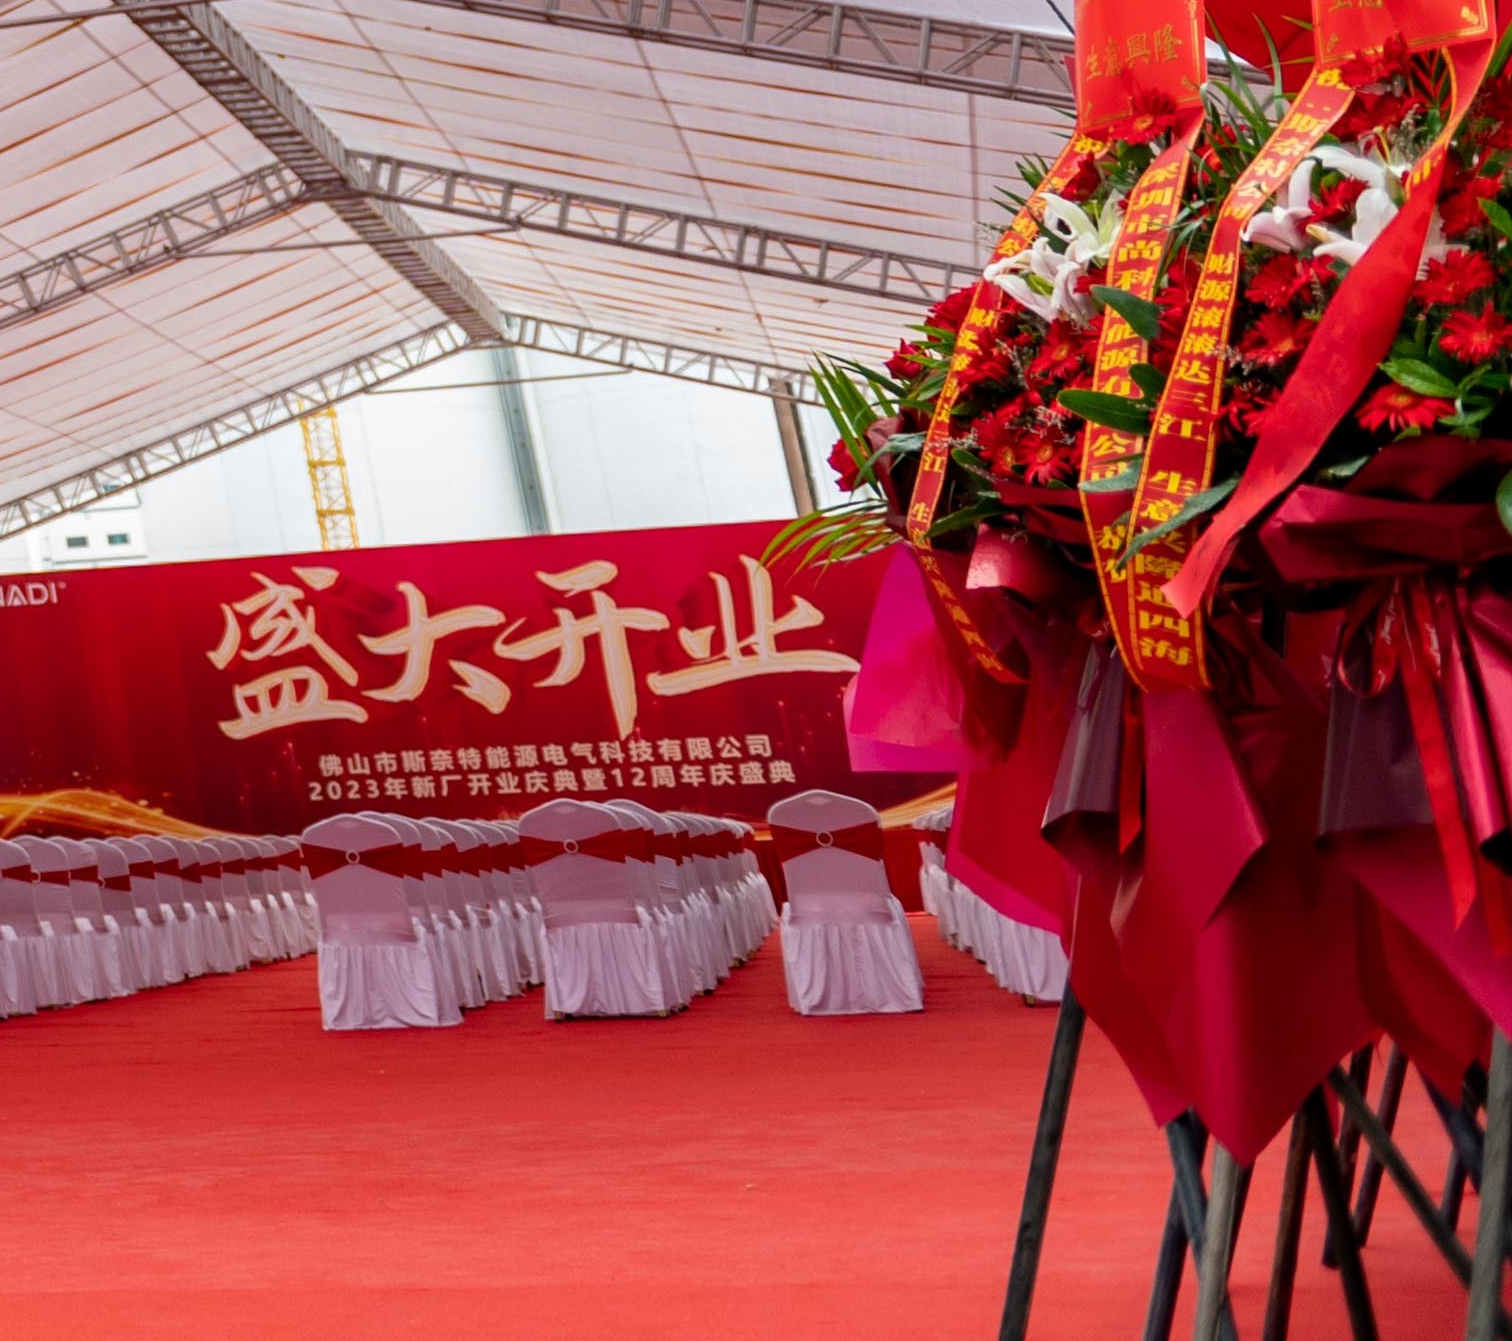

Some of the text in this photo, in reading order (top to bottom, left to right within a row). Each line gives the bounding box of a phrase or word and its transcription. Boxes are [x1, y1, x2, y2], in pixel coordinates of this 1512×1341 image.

[207, 554, 862, 741] 盛大开业
[318, 734, 774, 778] 佛山市斯奈特能源电气科技有限公司
[308, 759, 797, 802] 2023年新厂开业庆典暨12周年庆盛典
